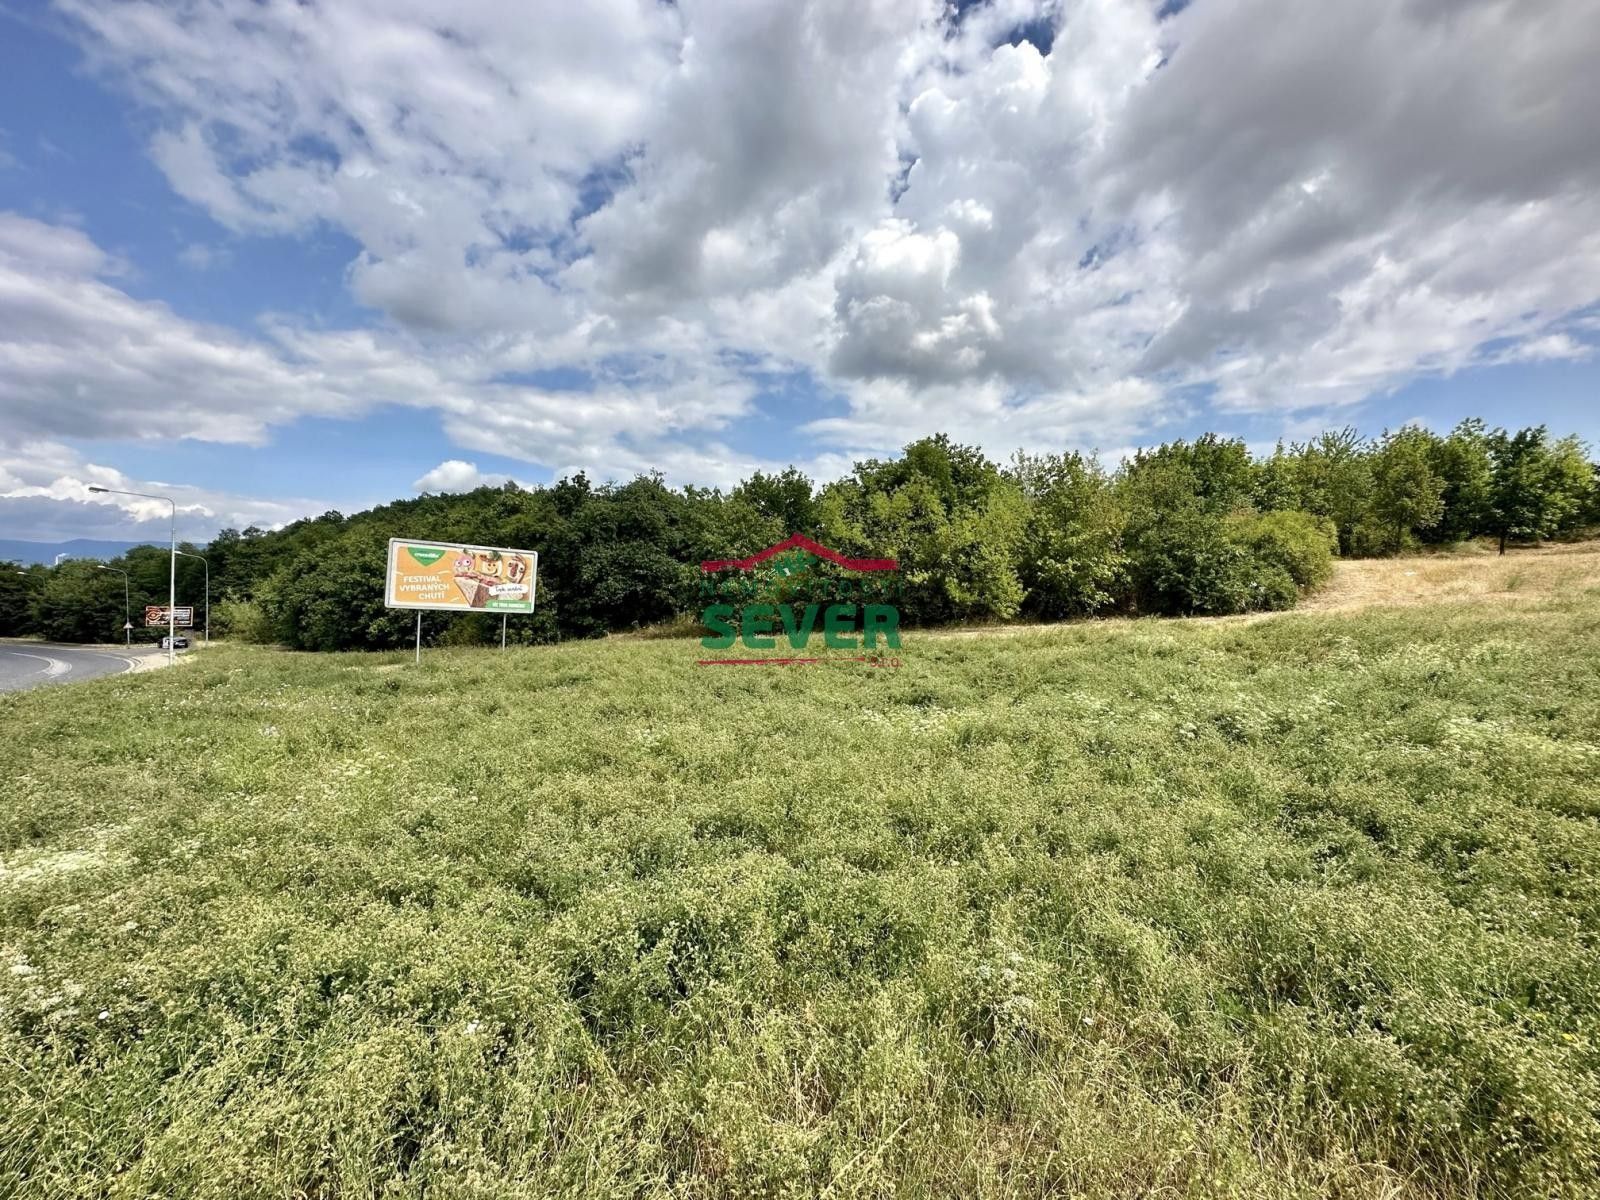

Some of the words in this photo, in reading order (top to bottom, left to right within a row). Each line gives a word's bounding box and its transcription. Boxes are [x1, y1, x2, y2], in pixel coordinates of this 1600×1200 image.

[403, 575, 440, 583] FESTIVAL
[400, 582, 449, 592] VYBRANÝCH
[419, 590, 444, 600] CHUTÍ
